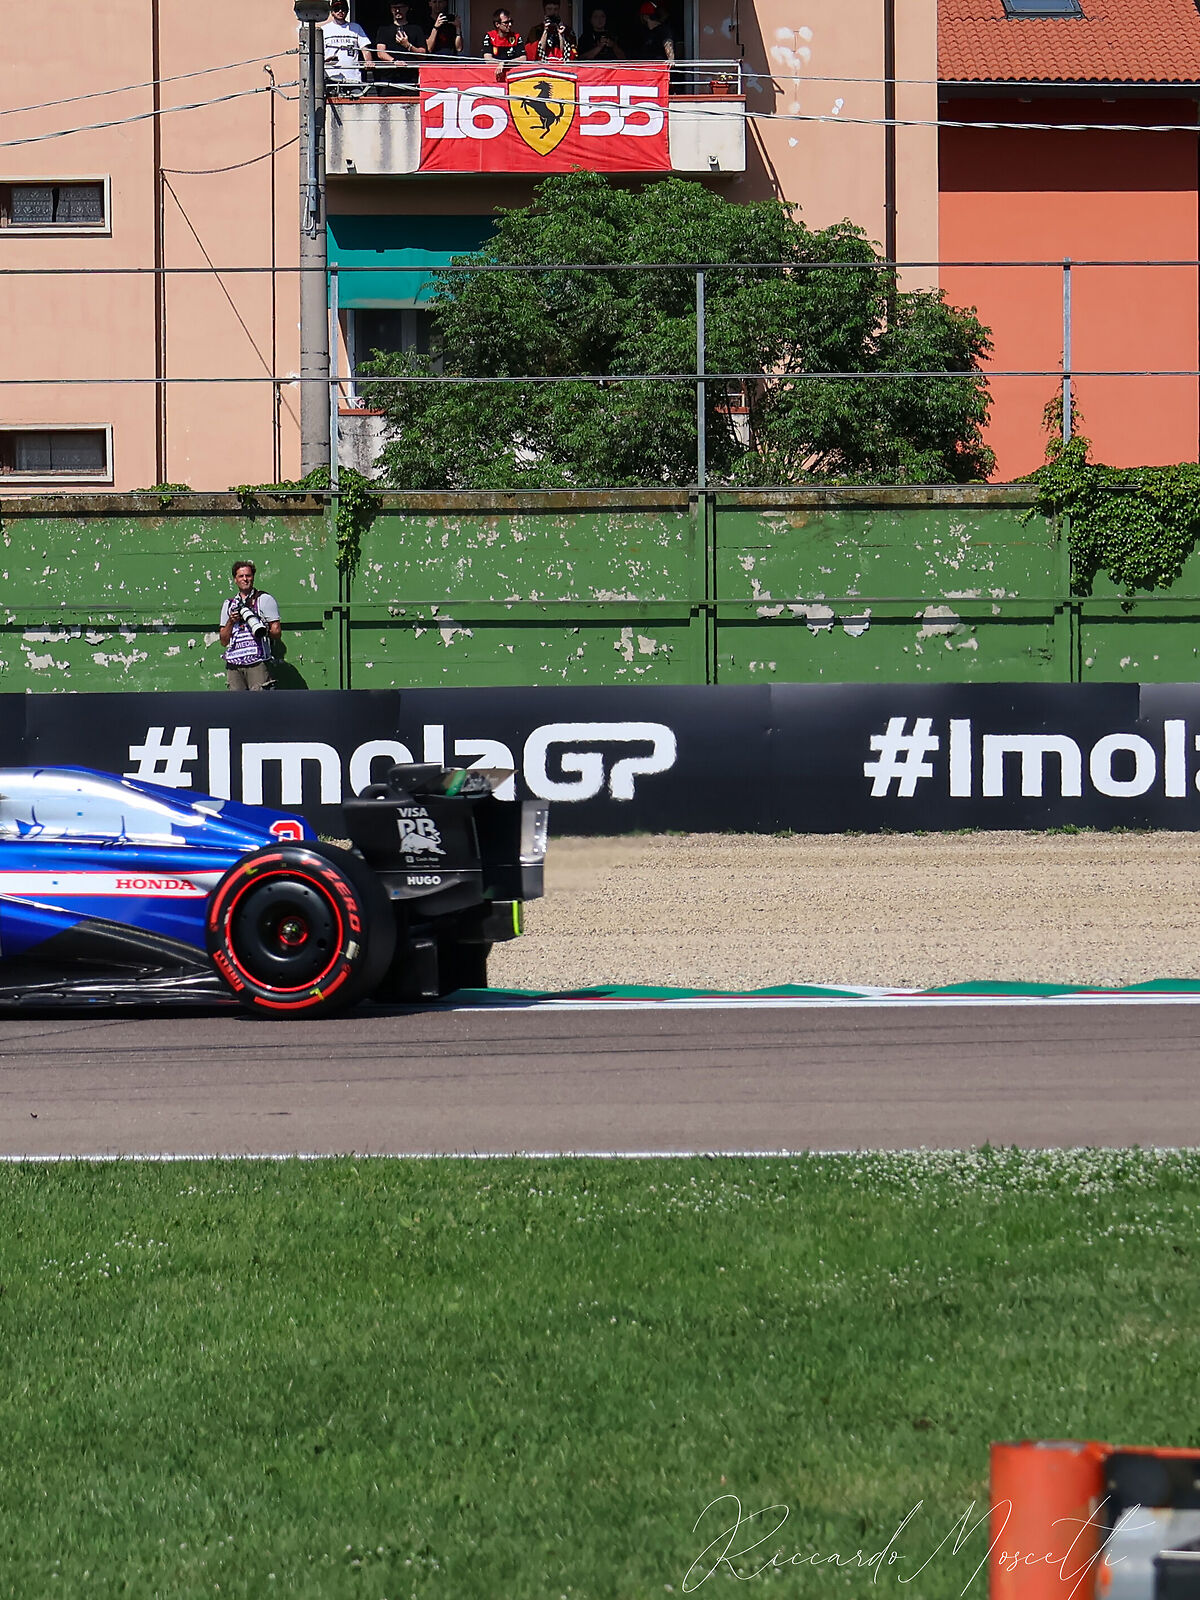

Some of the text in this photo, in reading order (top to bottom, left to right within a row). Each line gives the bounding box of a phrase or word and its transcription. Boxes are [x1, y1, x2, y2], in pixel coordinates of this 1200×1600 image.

[424, 85, 665, 139] 16 55
[863, 717, 1200, 797] #Imol
[397, 807, 428, 817] VISA
[115, 878, 198, 891] HONDA
[407, 876, 441, 885] HUGO
[321, 868, 361, 933] ZERO
